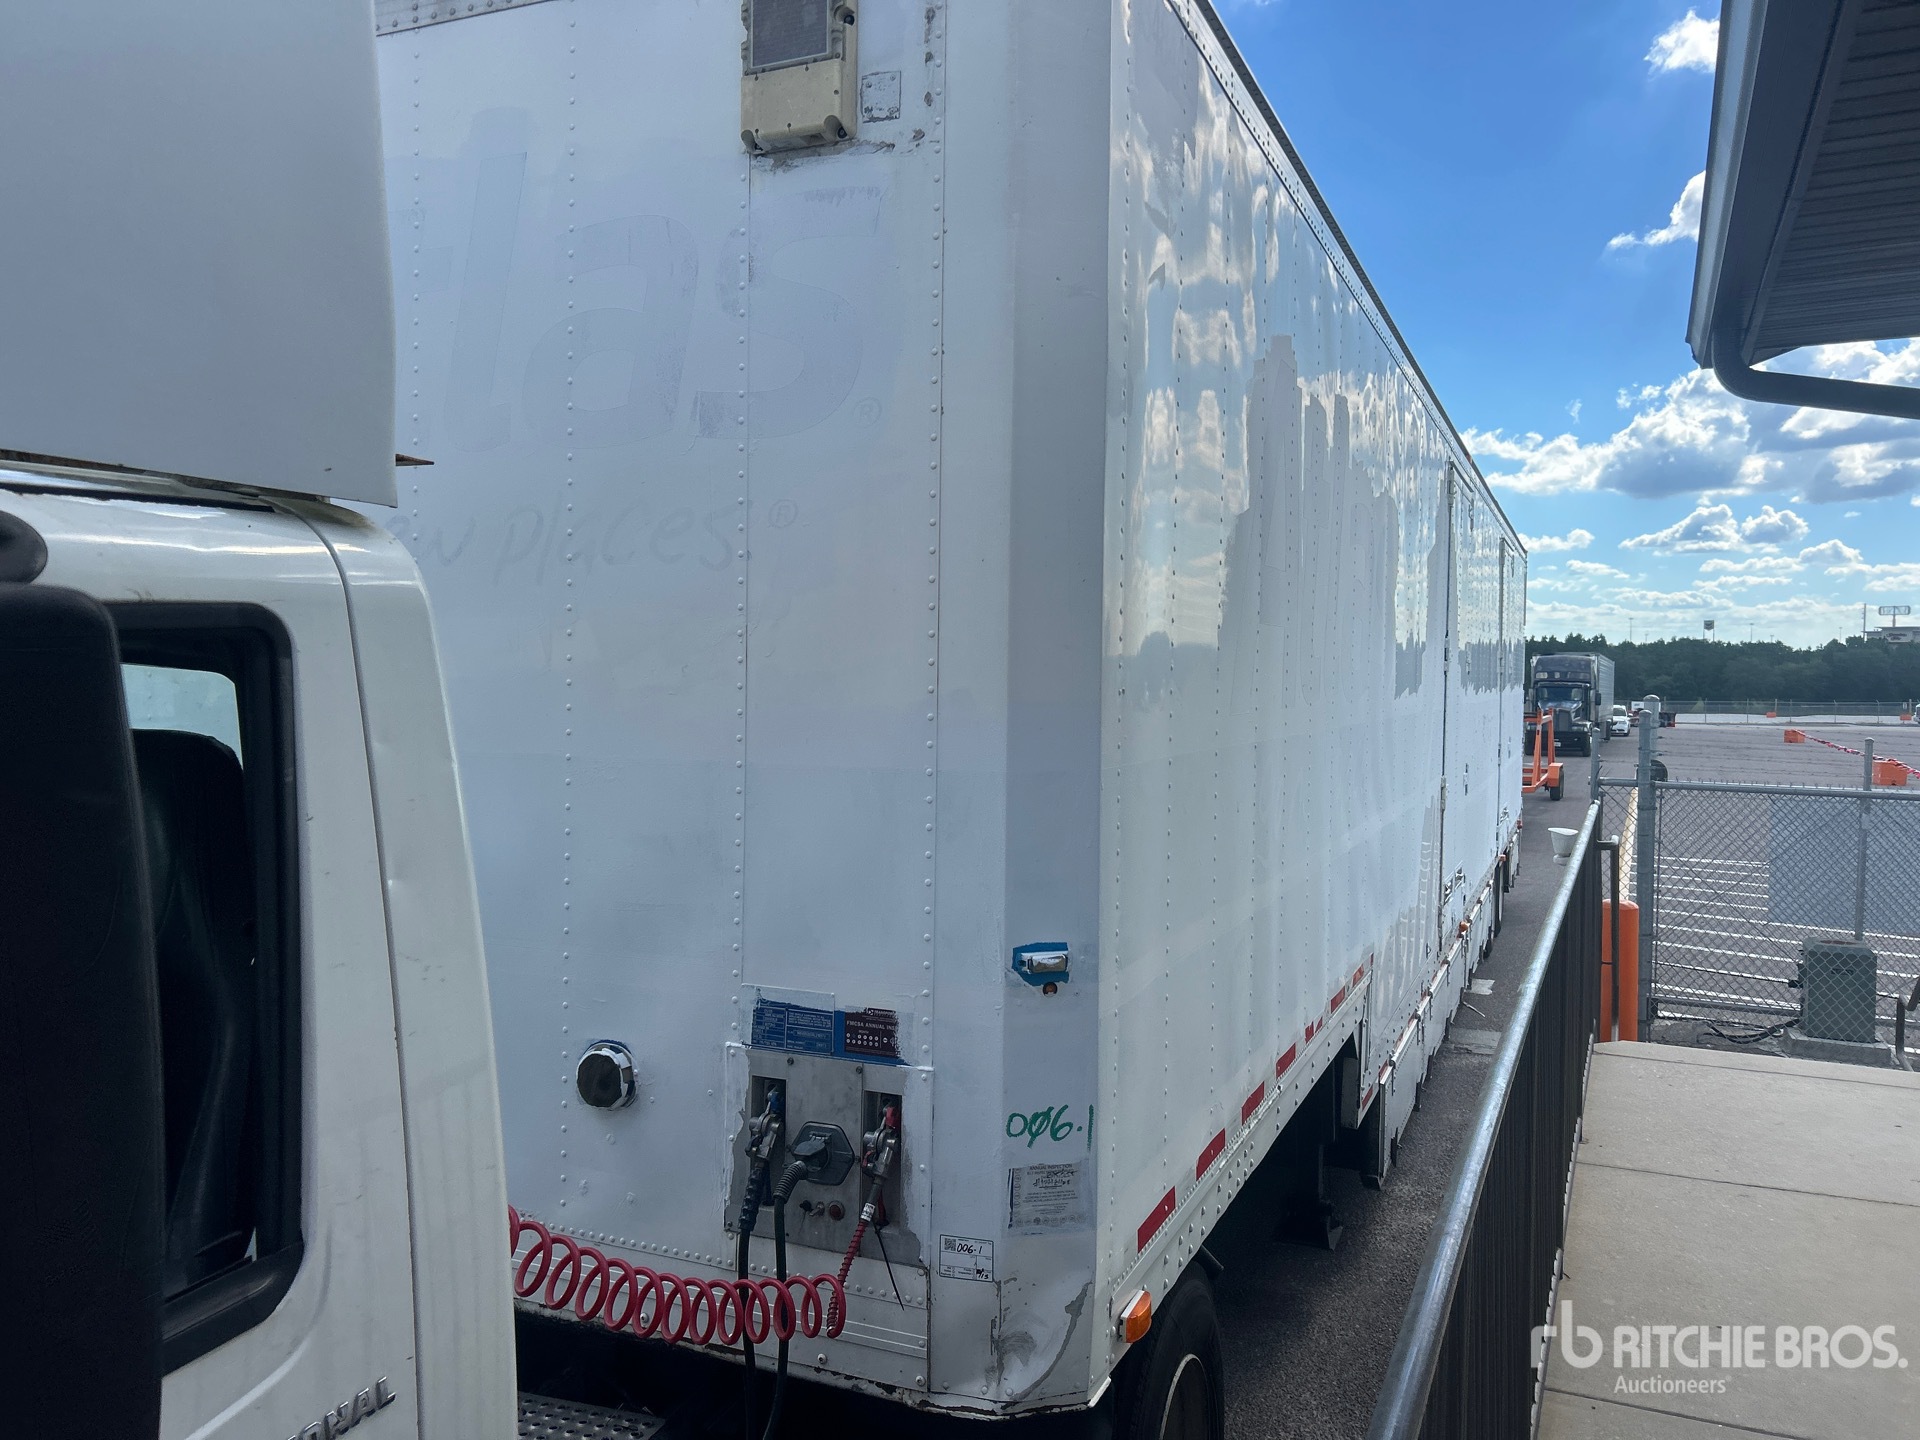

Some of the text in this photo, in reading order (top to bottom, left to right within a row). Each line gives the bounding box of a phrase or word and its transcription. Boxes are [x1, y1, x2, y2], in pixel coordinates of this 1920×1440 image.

[491, 490, 753, 587] places
[865, 1022, 886, 1030] ANNUAL
[286, 1376, 396, 1440] ONAL
